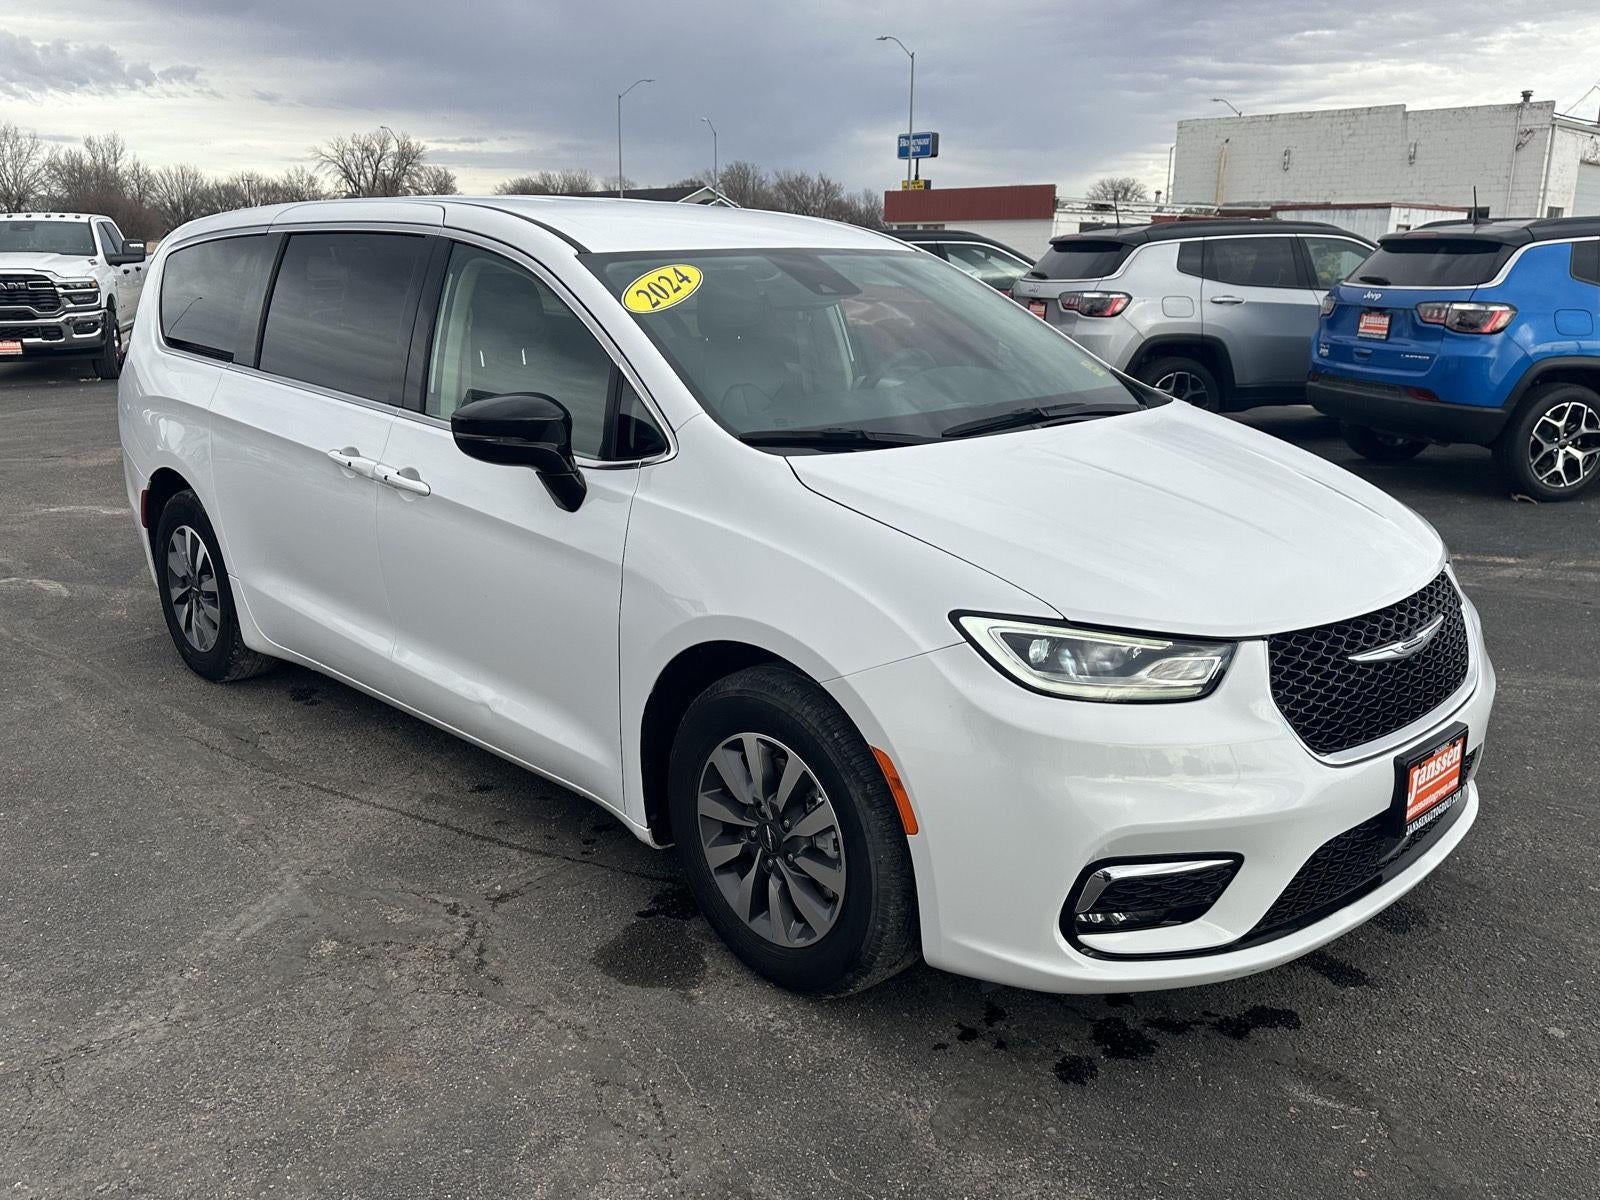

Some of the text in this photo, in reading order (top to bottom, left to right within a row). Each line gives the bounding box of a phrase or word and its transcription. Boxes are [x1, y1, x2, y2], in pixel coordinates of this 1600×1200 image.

[900, 138, 930, 147] ROEWAY
[0, 282, 26, 290] AM
[636, 267, 692, 309] 2024
[1363, 290, 1382, 301] Jeep
[1407, 742, 1462, 807] Janssen
